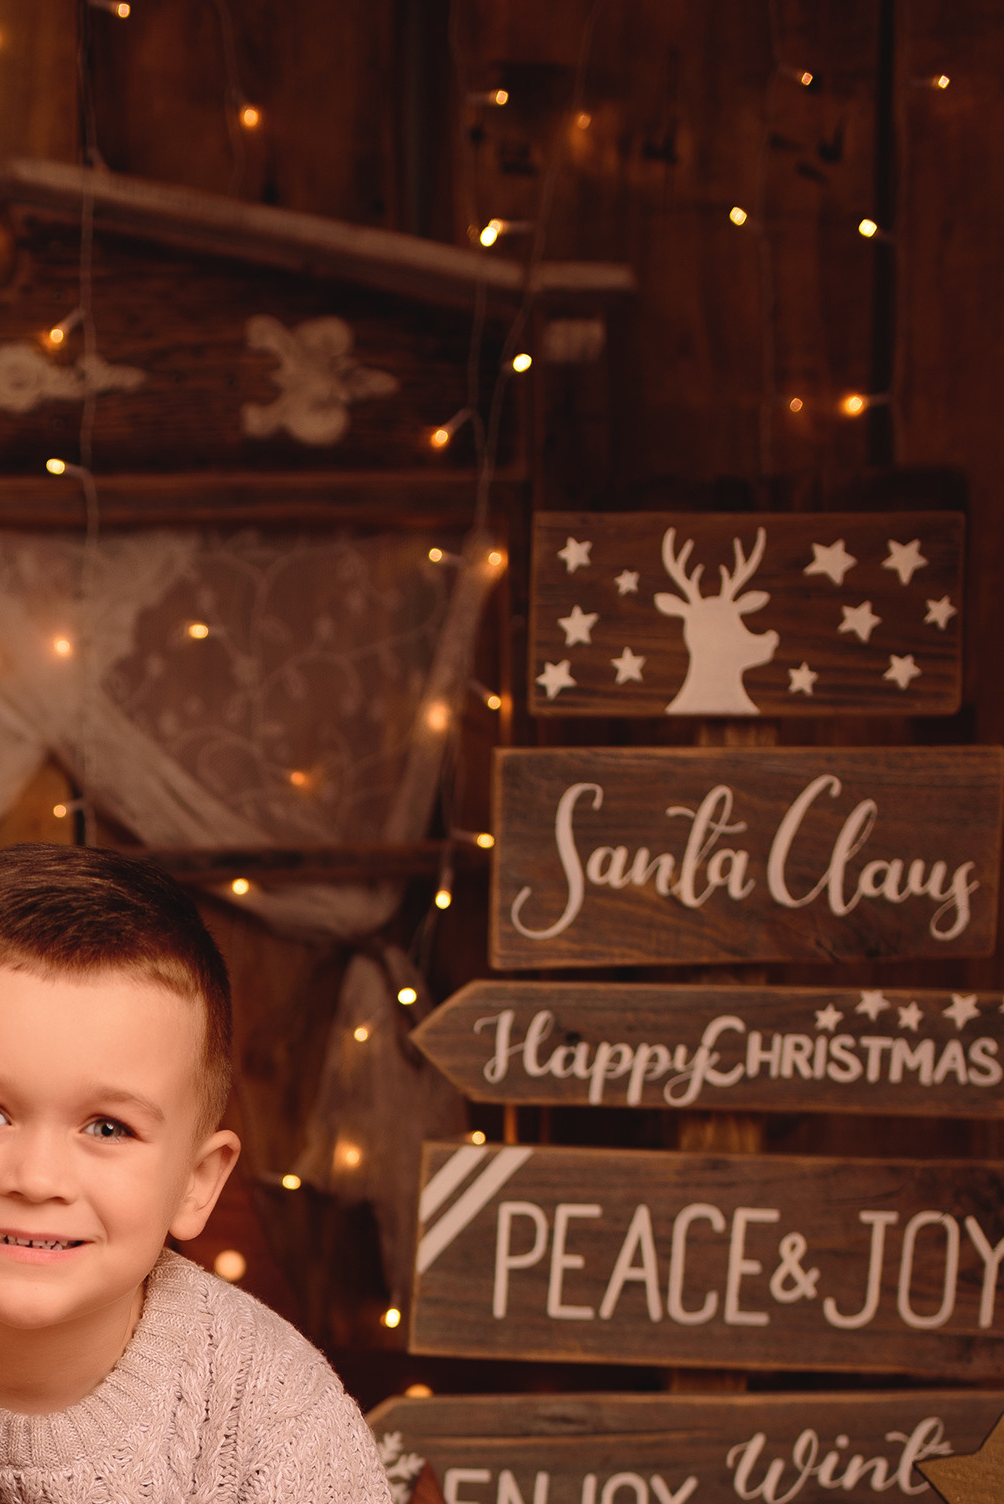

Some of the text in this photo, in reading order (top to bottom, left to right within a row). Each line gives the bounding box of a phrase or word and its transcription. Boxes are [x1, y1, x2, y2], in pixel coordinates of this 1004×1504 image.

[510, 774, 979, 941] Santa Claus
[473, 1009, 1003, 1107] Happy CHRISTMAS
[823, 1209, 1004, 1330] JOY
